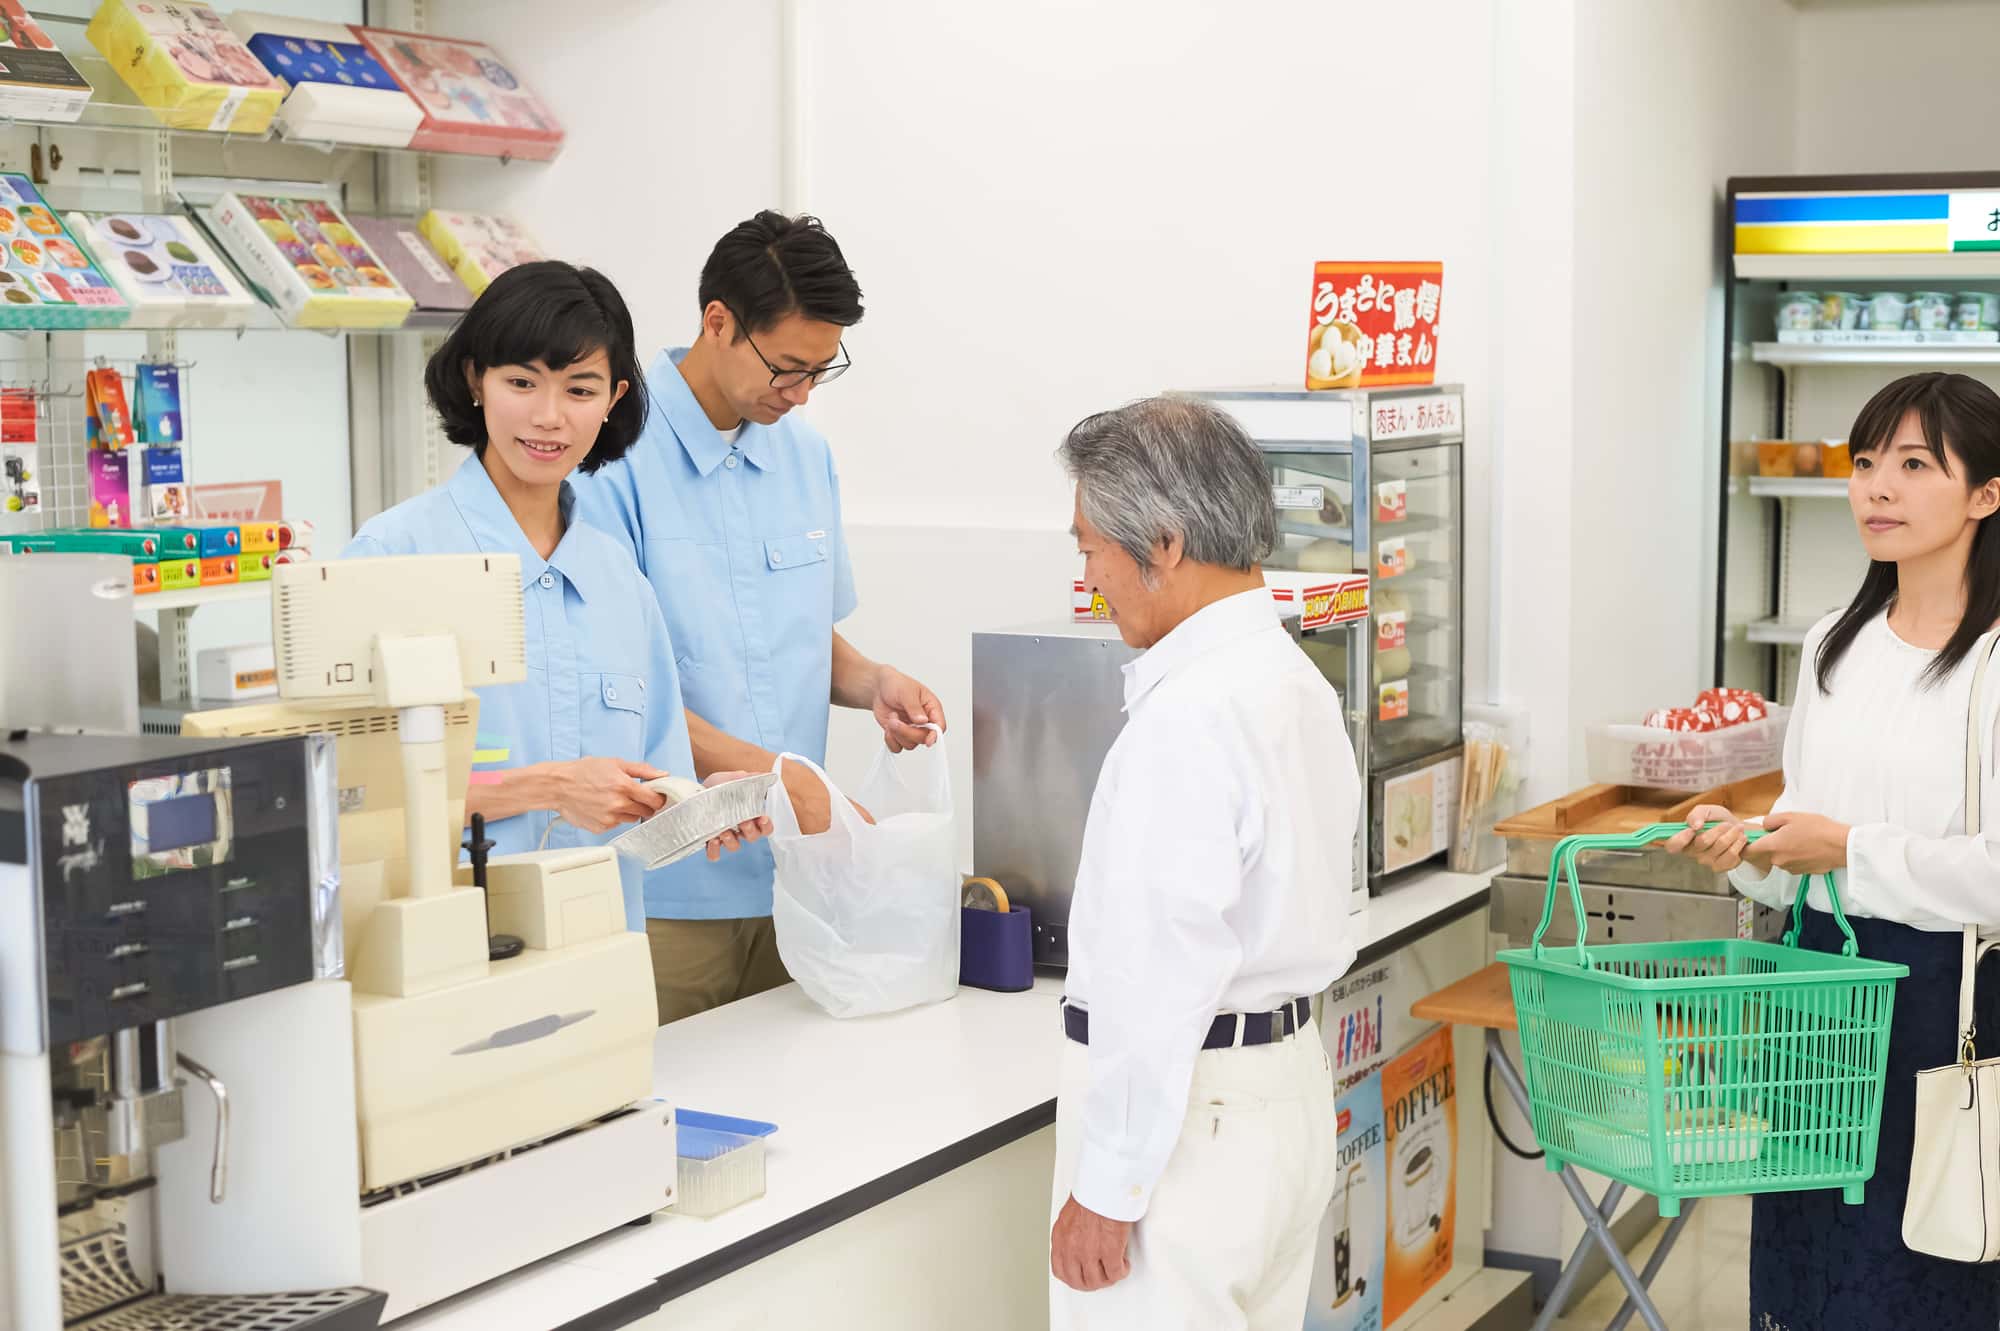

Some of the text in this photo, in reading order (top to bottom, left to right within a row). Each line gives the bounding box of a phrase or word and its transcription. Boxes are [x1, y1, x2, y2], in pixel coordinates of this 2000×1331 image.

[1356, 332, 1433, 369] 中華まん
[1376, 402, 1456, 434] 肉まん・あんまん
[1384, 1063, 1455, 1142] COFFEE
[1336, 1123, 1381, 1172] COFFEE
